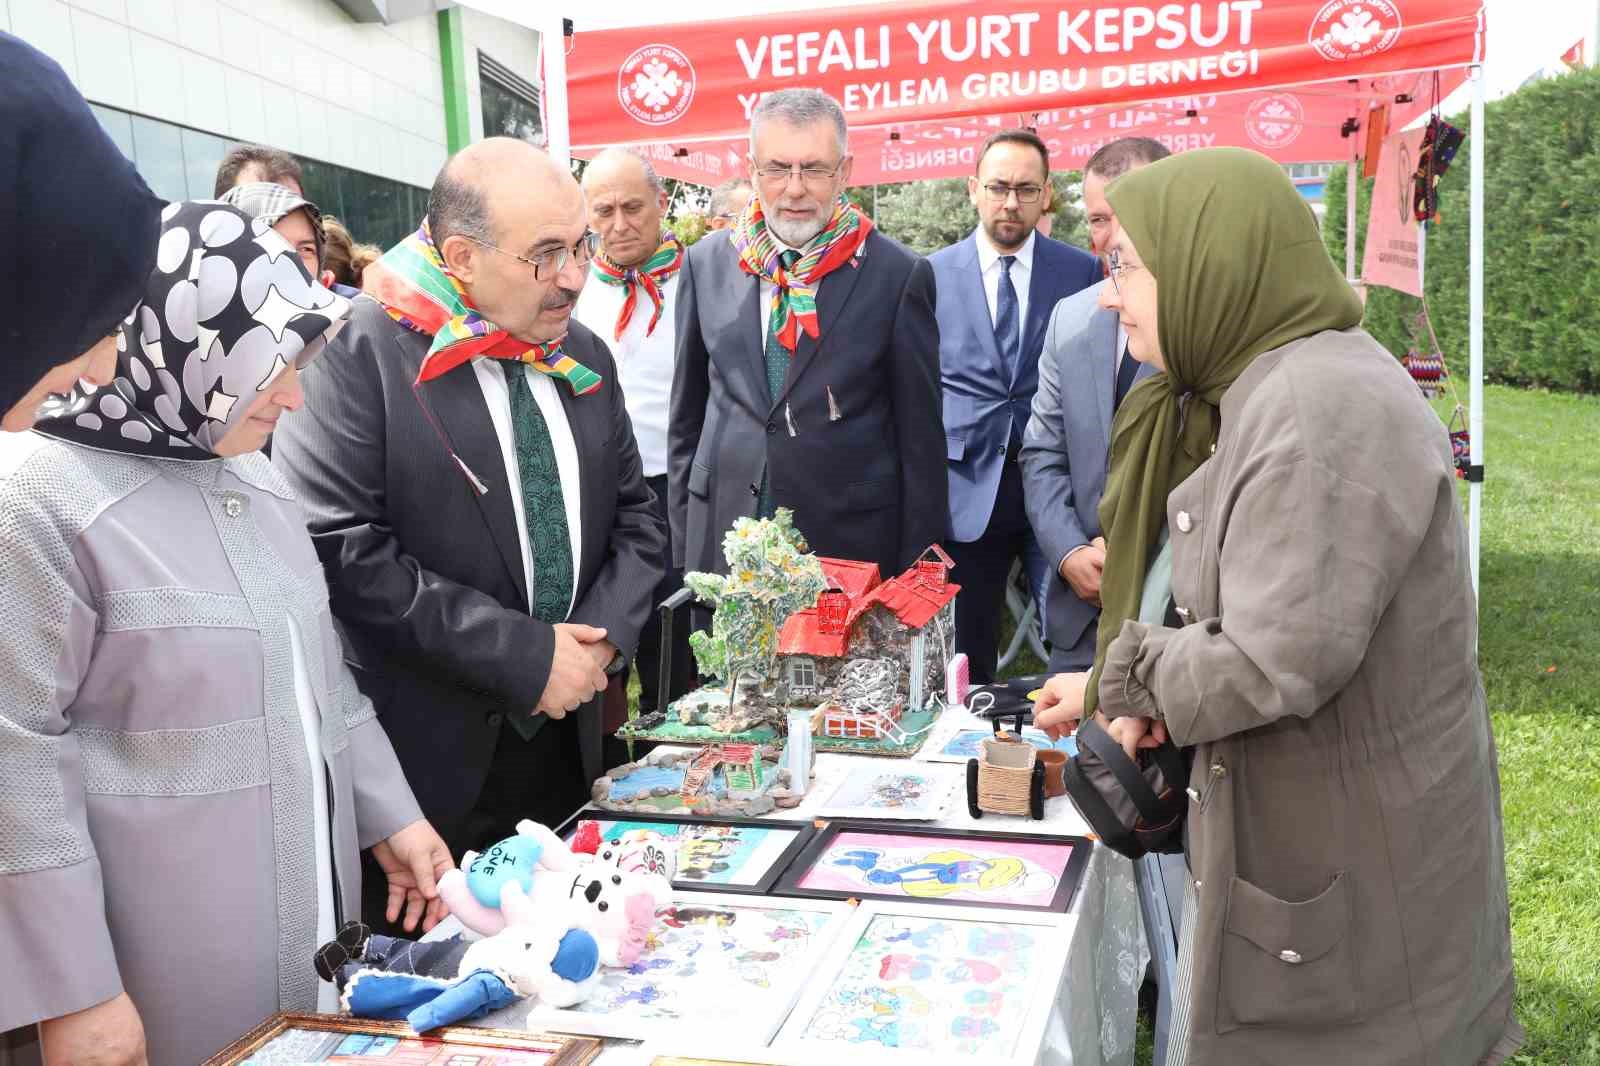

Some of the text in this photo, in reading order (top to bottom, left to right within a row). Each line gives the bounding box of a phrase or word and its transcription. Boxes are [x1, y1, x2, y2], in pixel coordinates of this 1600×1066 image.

[735, 0, 1263, 80] VEFALI YURT KEPSUT
[843, 76, 949, 113] EYLEM
[962, 62, 1088, 101] GRUBU
